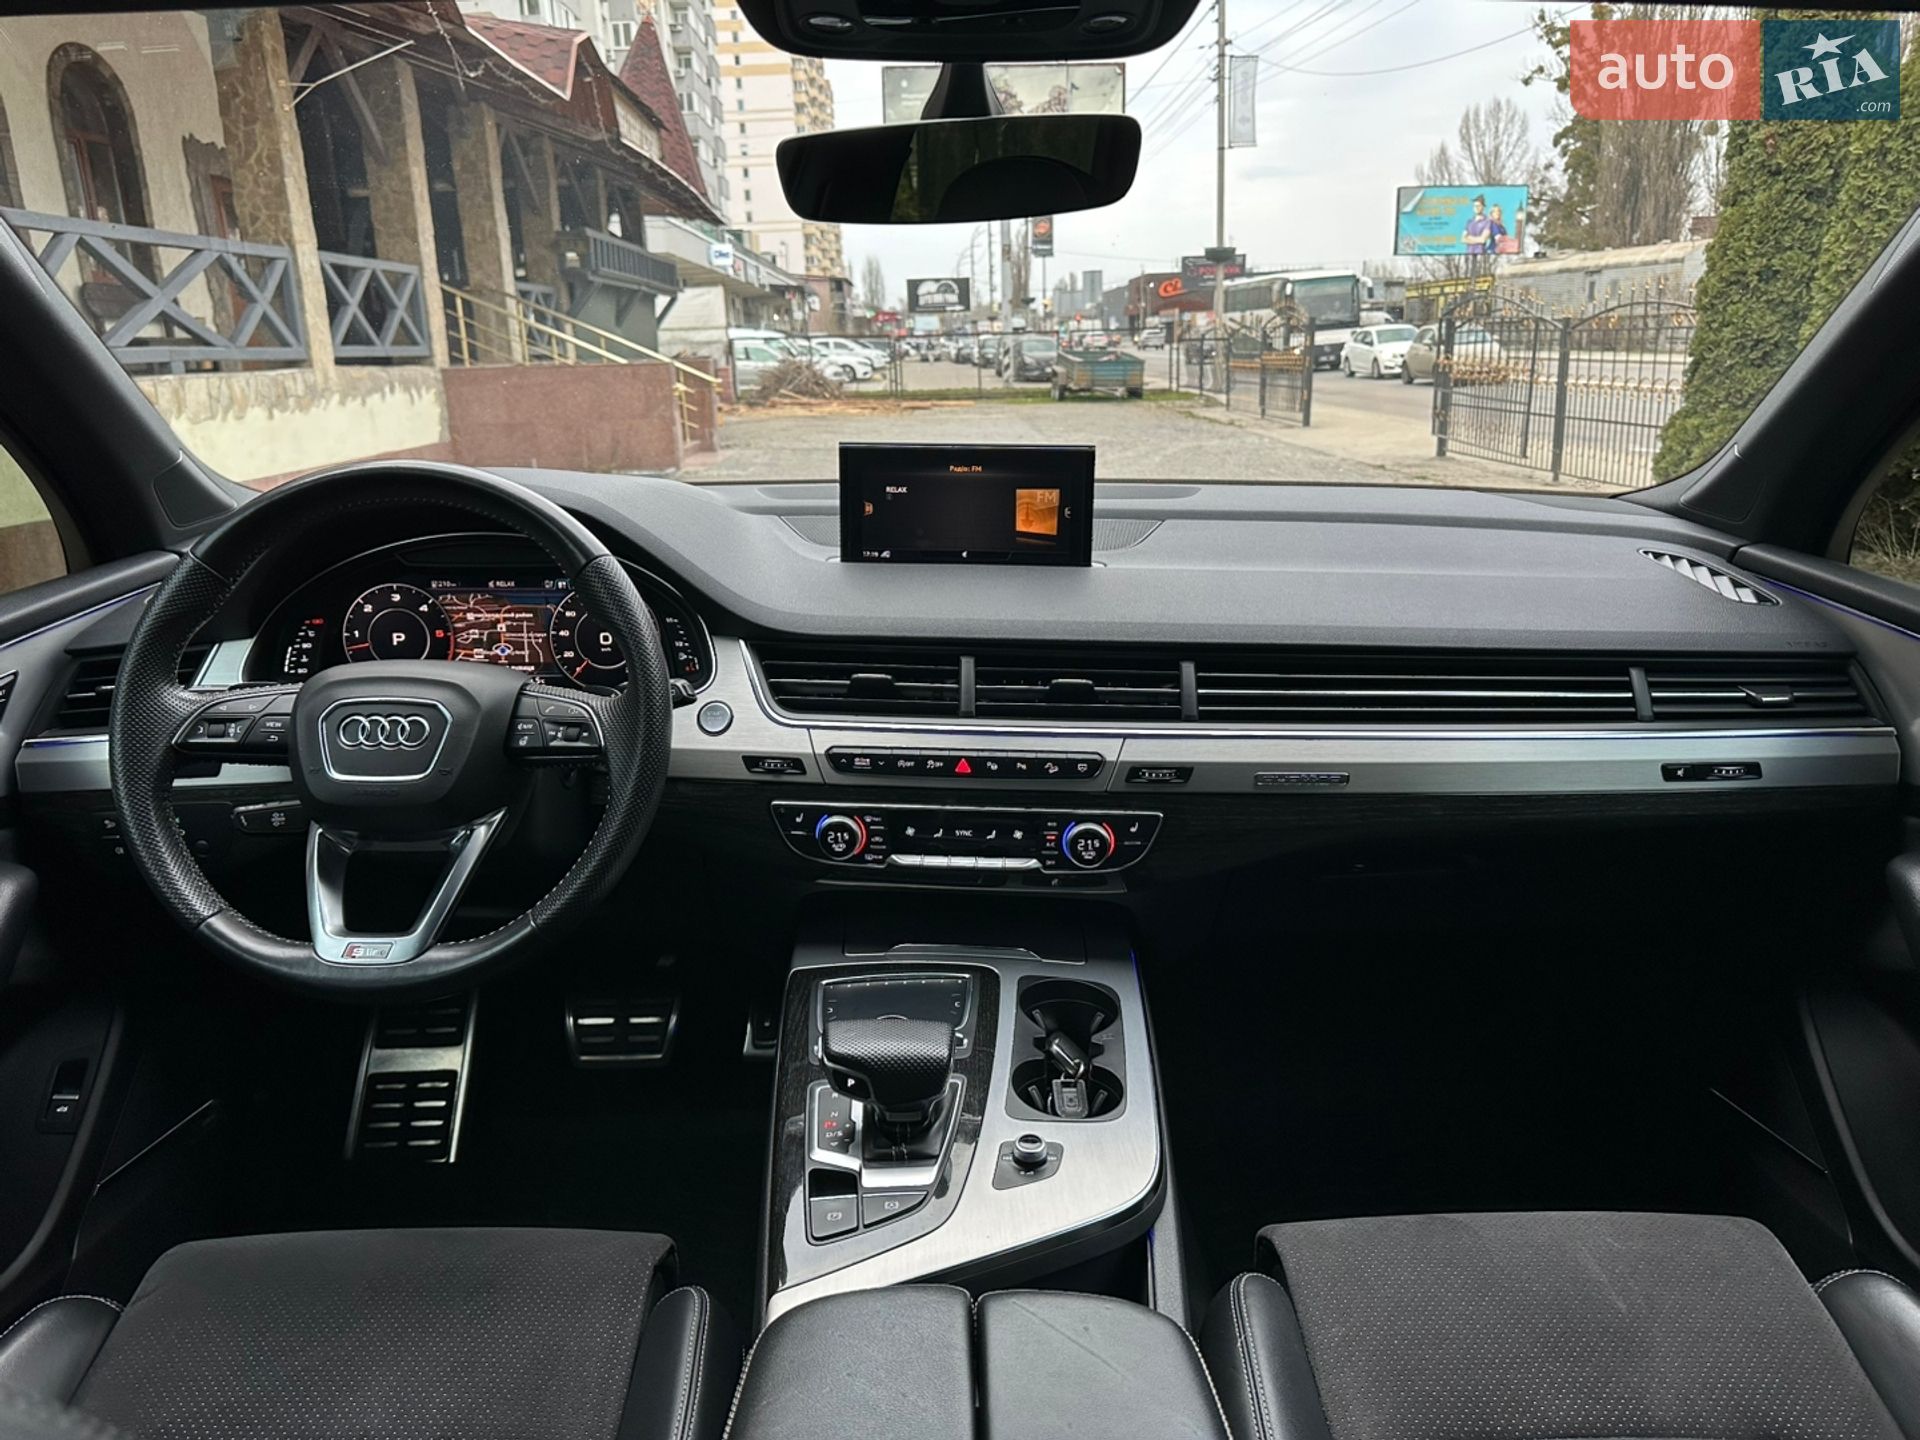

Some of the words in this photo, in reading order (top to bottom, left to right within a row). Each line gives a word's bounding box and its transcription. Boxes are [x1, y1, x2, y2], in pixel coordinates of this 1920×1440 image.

[1036, 491, 1056, 503] FM
[391, 594, 401, 602] 3
[363, 604, 373, 613] 2
[418, 604, 429, 612] 4
[353, 630, 359, 638] 1
[435, 630, 445, 638] 5
[392, 632, 406, 646] P
[955, 829, 973, 837] SYNC
[847, 1077, 855, 1087] P
